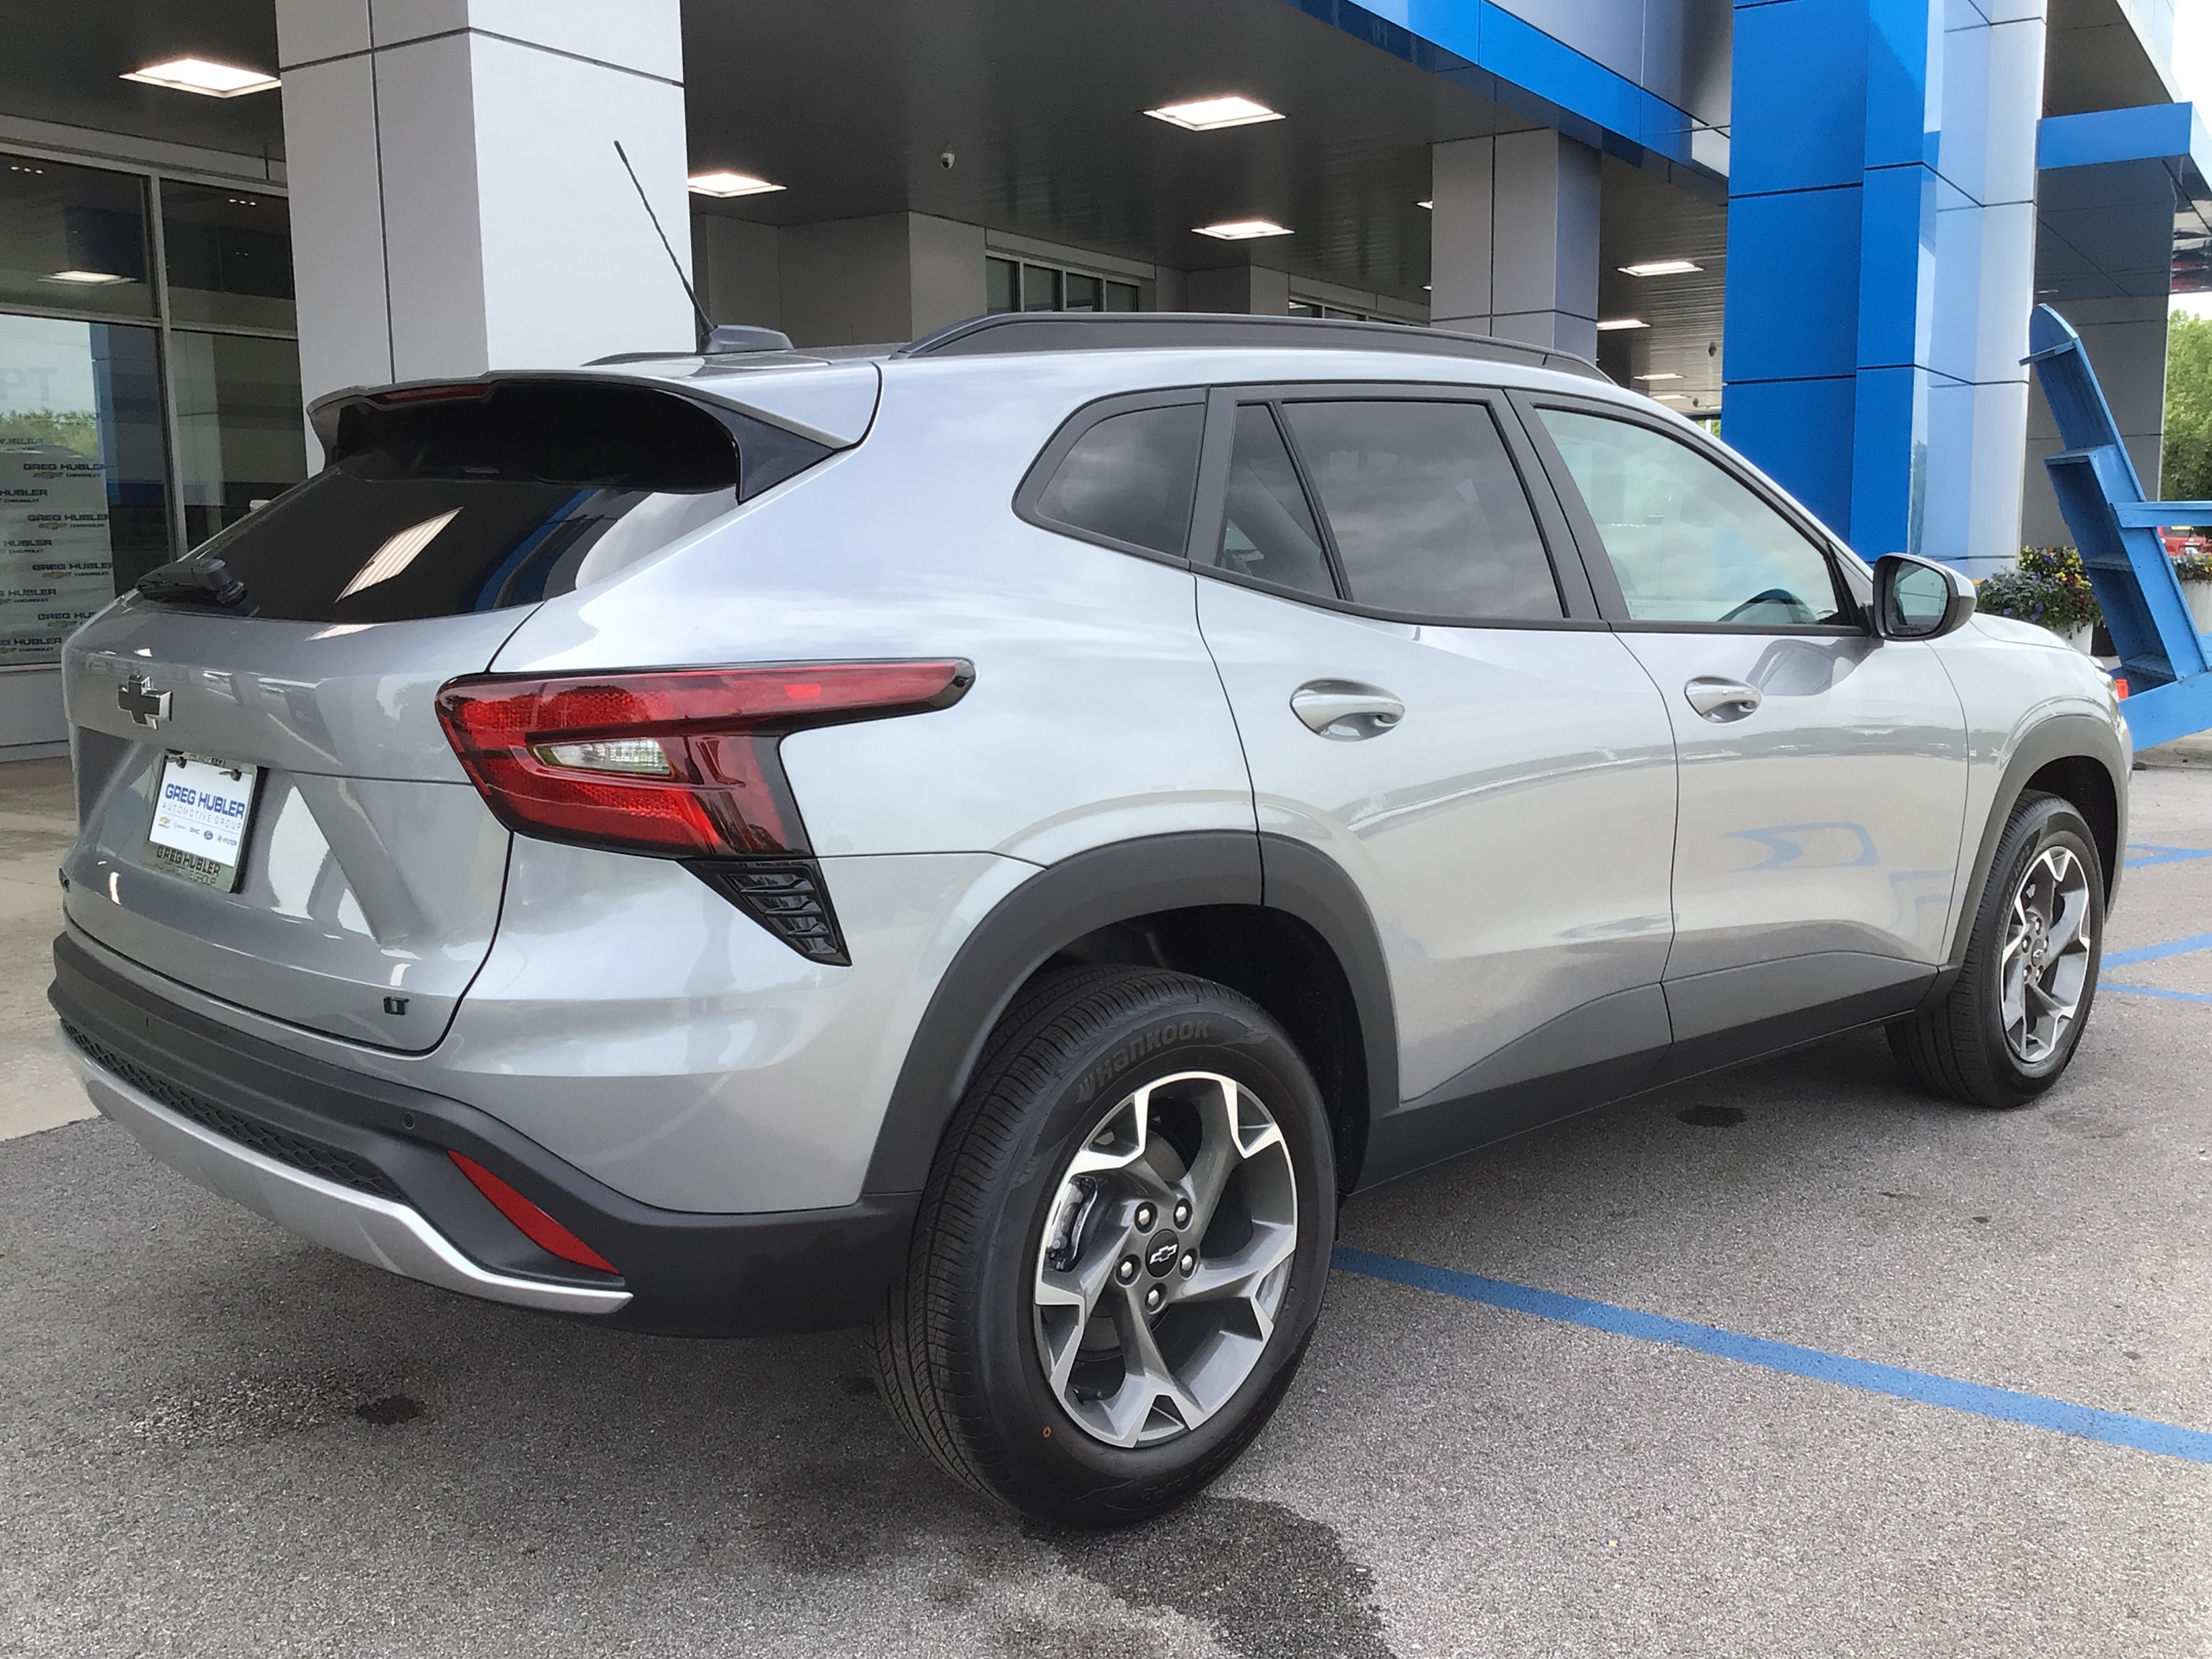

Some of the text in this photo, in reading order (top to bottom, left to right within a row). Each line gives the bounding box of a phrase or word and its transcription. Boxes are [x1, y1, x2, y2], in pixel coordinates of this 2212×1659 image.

[8, 588, 57, 596] HUBLER
[165, 783, 245, 819] GREG HUBLER
[162, 802, 242, 830] AUTOMOTIVE GROUP
[156, 844, 220, 877] GREG HUBLER
[384, 997, 409, 1015] LT
